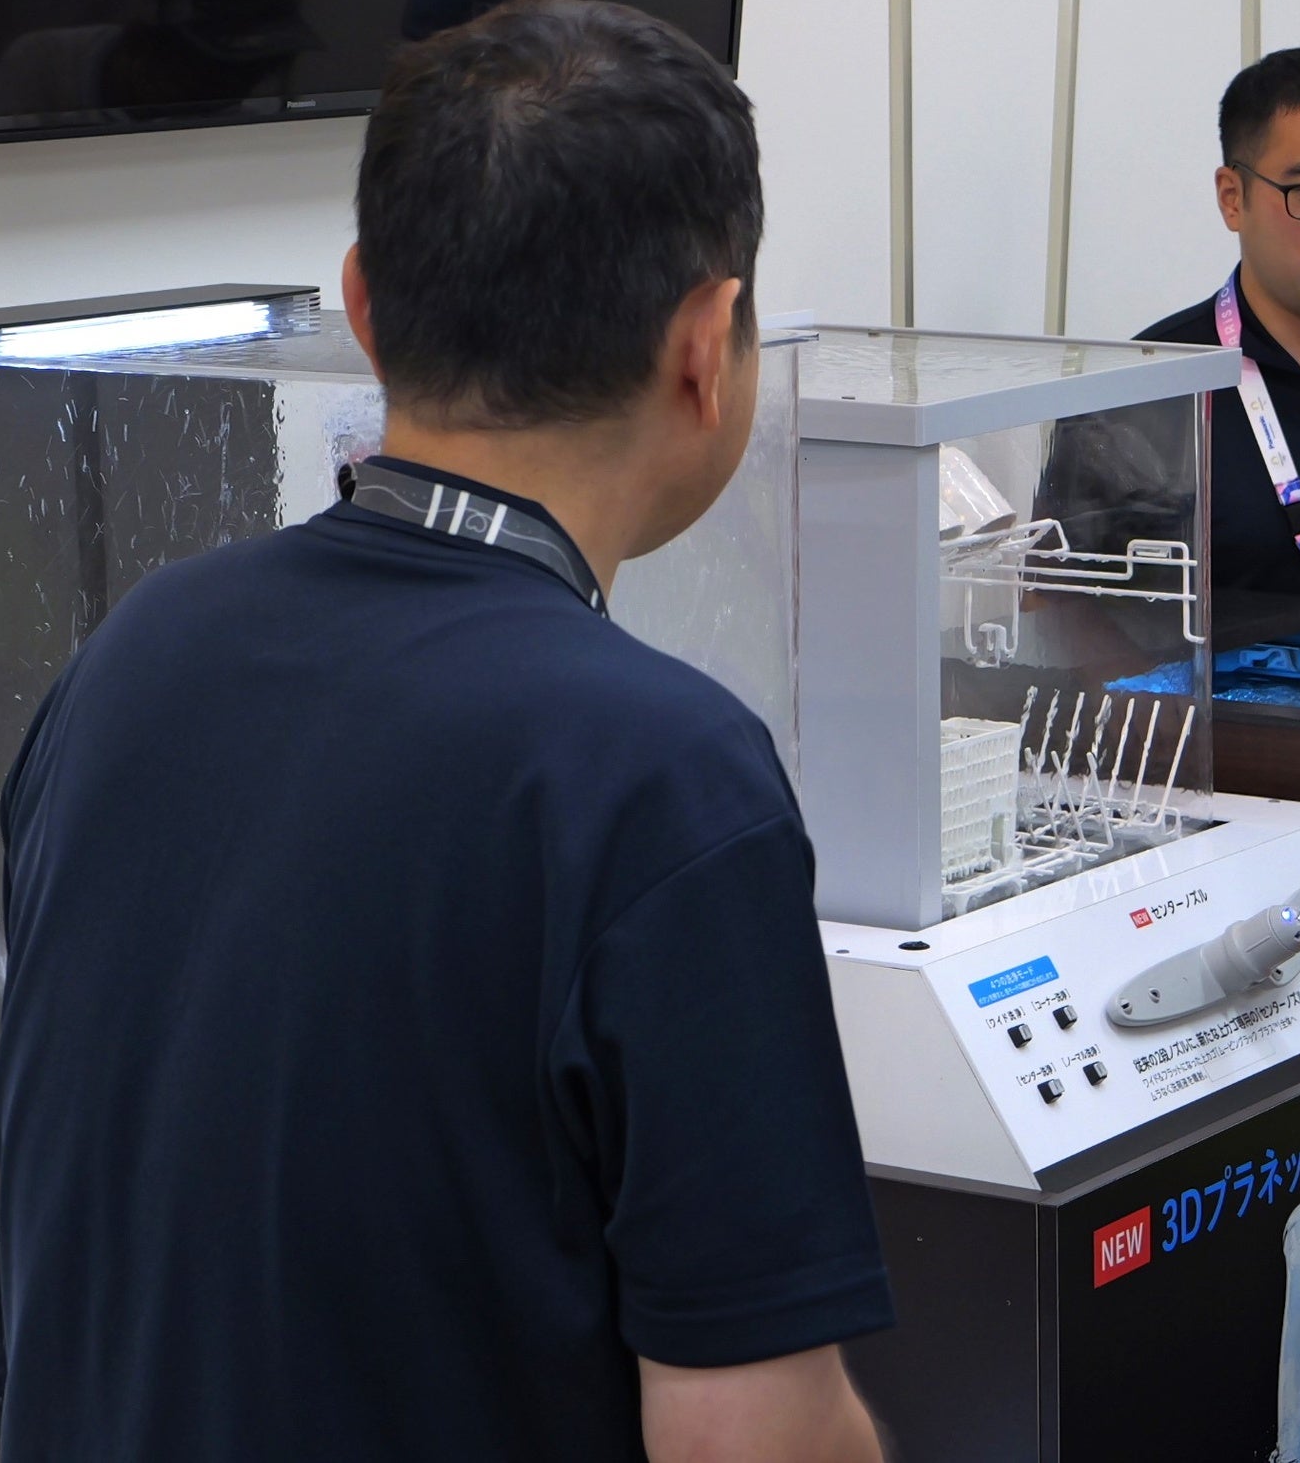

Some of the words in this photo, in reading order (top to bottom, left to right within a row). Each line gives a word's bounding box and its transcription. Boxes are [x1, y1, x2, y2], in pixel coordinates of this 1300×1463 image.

[1151, 888, 1208, 920] センターノズル
[1101, 1221, 1145, 1273] NEW
